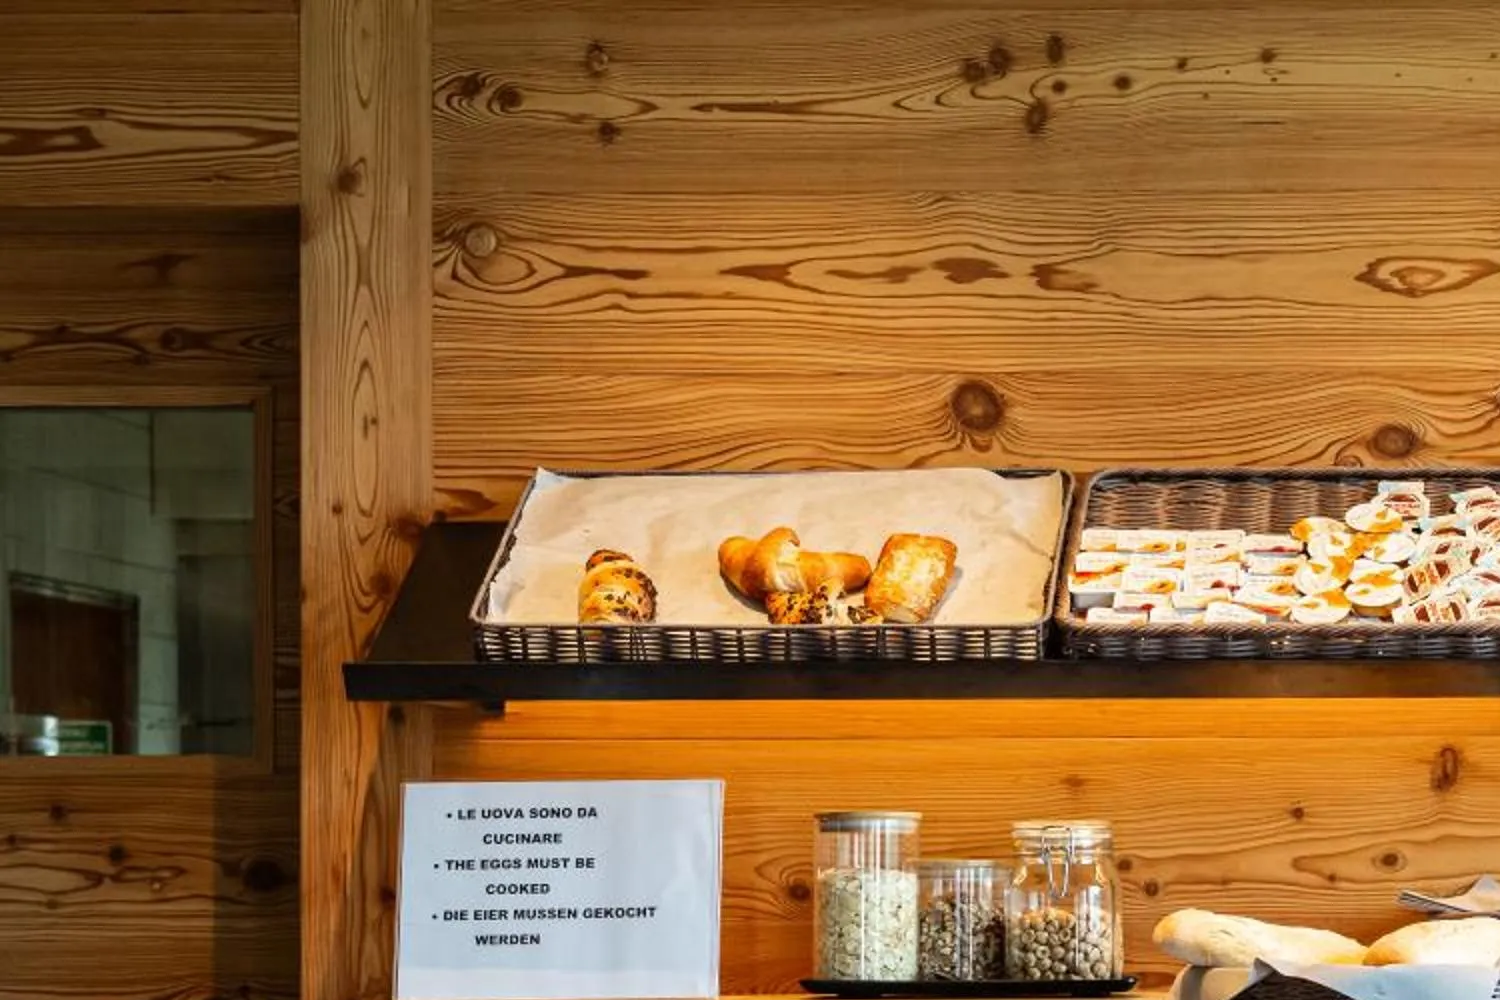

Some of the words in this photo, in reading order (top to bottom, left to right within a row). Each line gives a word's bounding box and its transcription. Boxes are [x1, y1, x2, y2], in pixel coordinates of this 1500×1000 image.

[457, 808, 476, 820] LE
[481, 808, 525, 820] UOVA
[529, 807, 573, 819] SONO
[577, 807, 598, 819] DA
[483, 833, 563, 845] CUCINARE
[445, 859, 475, 871] THE
[480, 858, 522, 870] EGGS
[526, 857, 571, 869] MUST
[575, 857, 596, 869] BE
[485, 883, 551, 895] COOKED
[443, 909, 469, 921] DIE
[473, 909, 508, 921] EIER
[513, 908, 578, 920] MUSSEN
[582, 907, 657, 919] GEKOCHT
[475, 934, 541, 946] WERDEN
